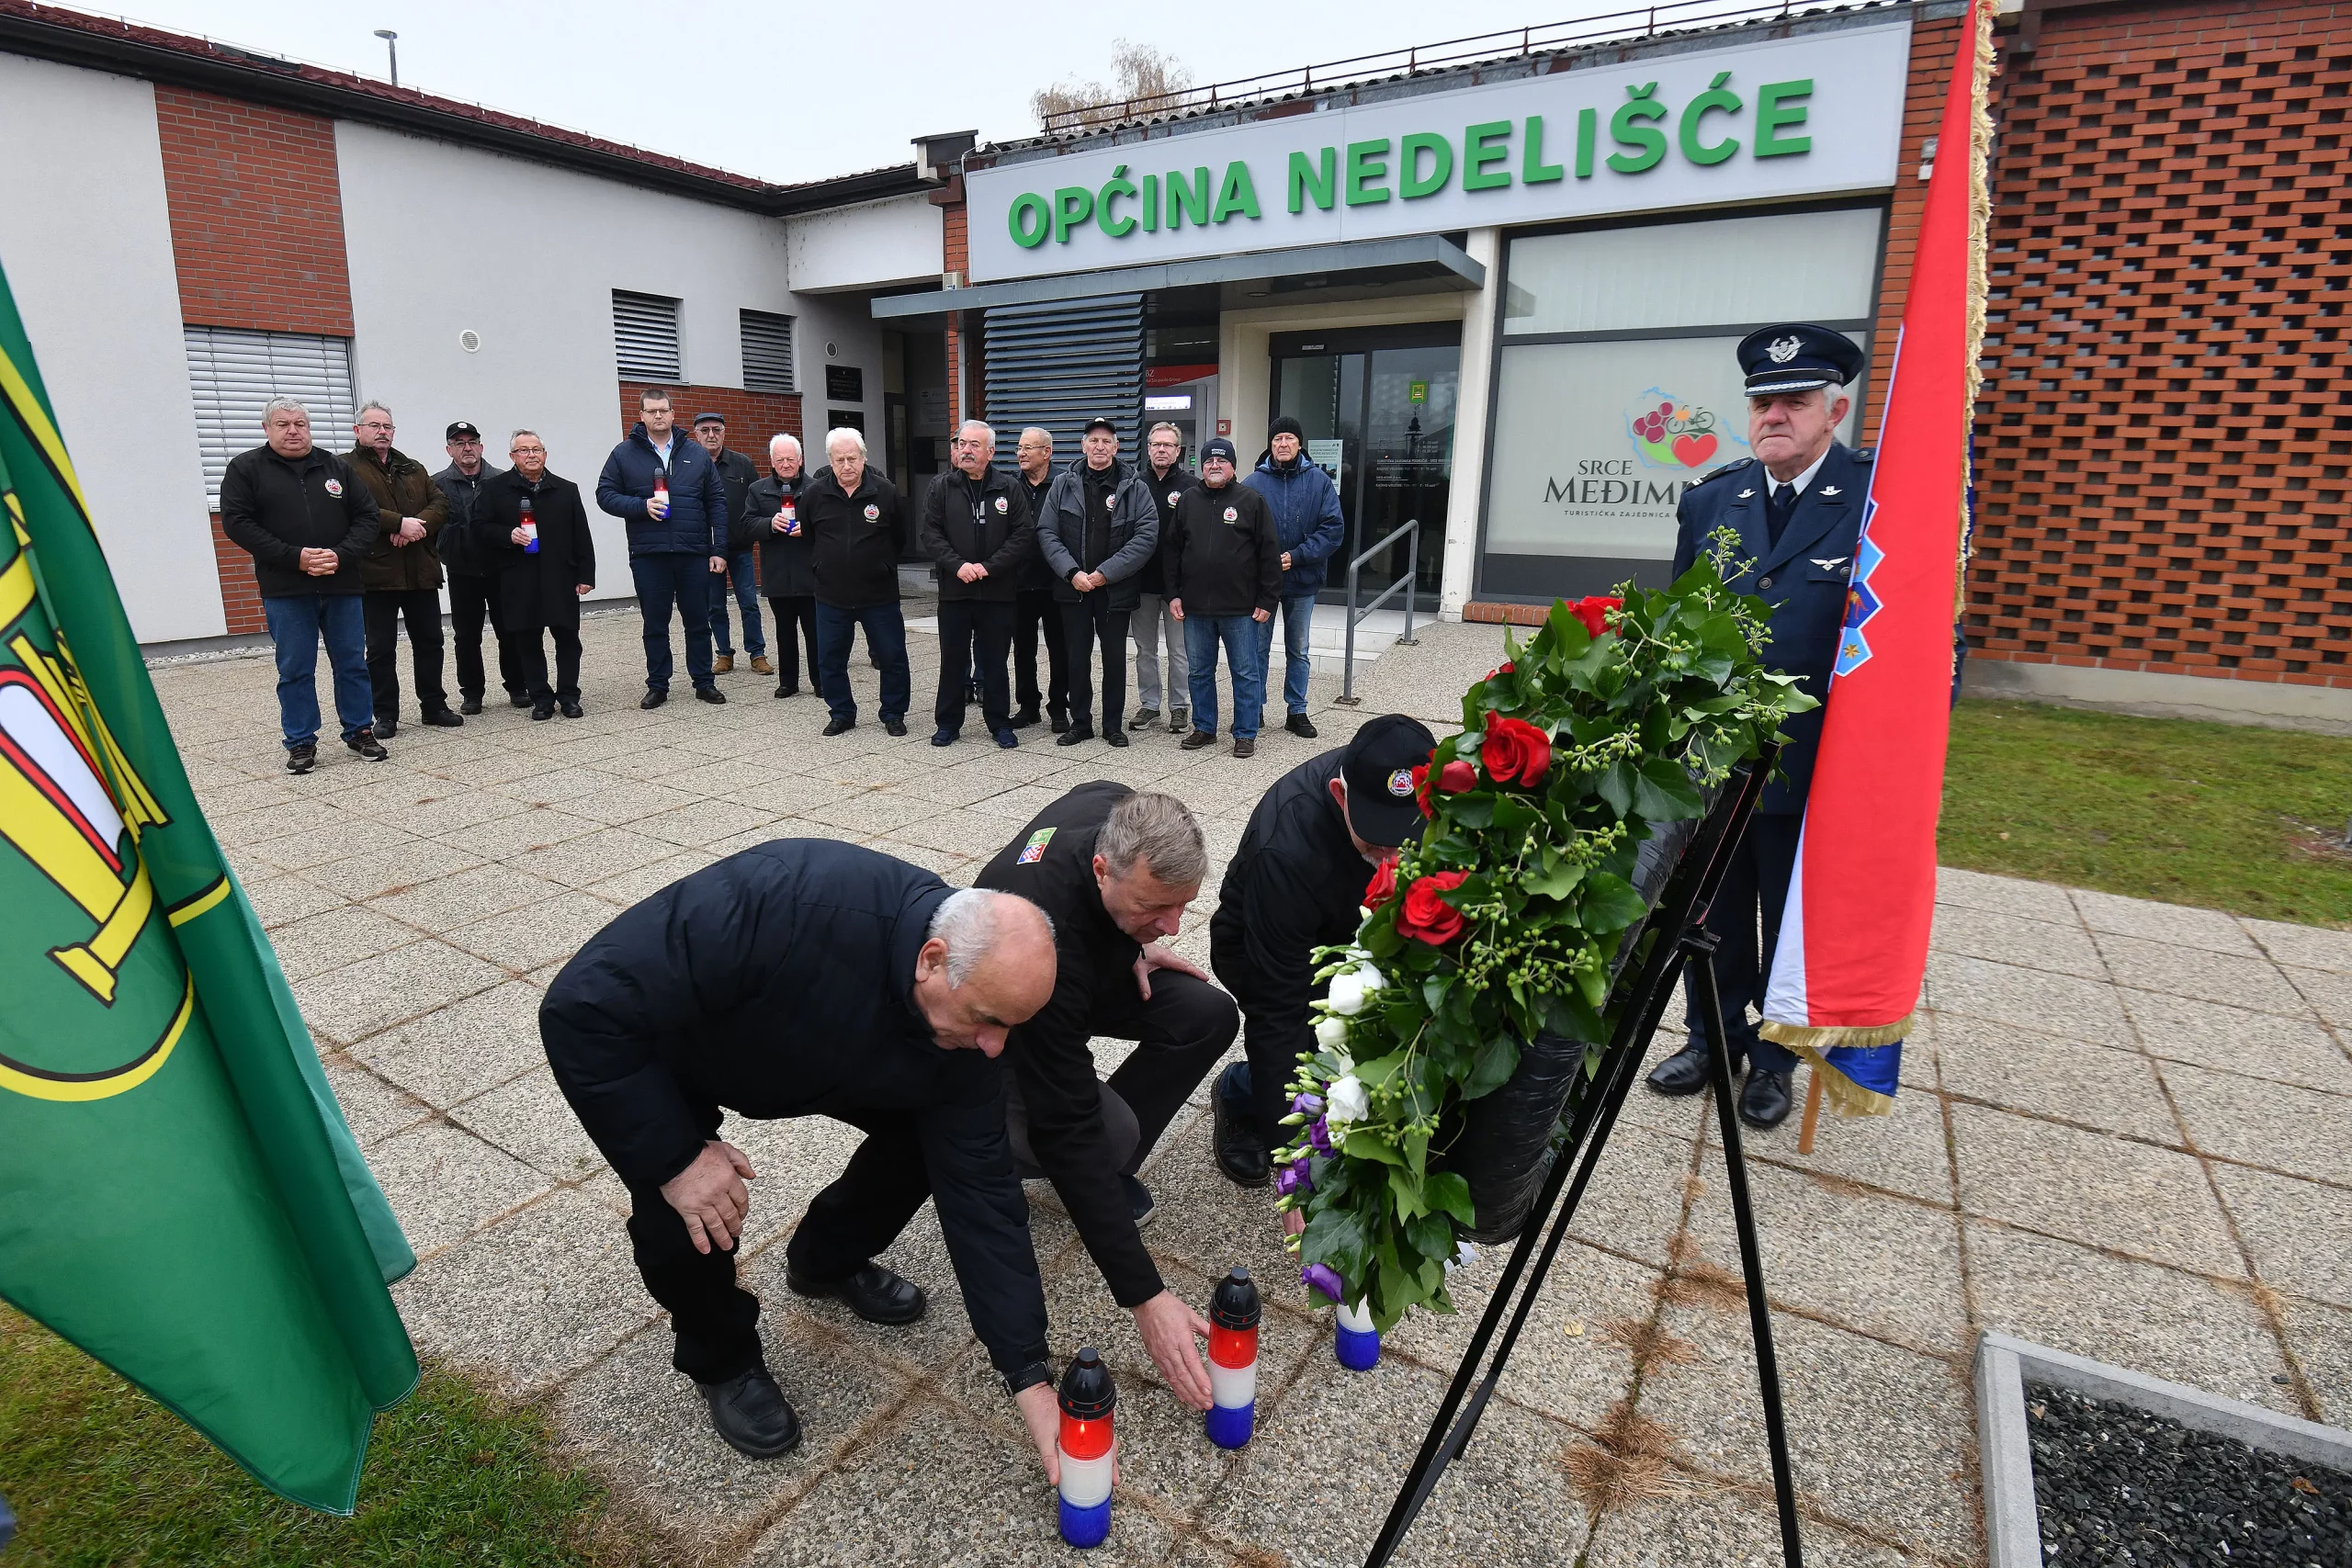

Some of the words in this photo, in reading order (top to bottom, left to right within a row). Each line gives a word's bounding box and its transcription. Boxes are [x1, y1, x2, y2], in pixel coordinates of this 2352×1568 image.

[1008, 161, 1261, 249] OPĆINA
[1287, 72, 1814, 213] NEDELIŠĆE
[1577, 459, 1634, 476] SRCE
[1542, 475, 1690, 505] MEĐIM
[1564, 508, 1616, 517] TURISTIČKA
